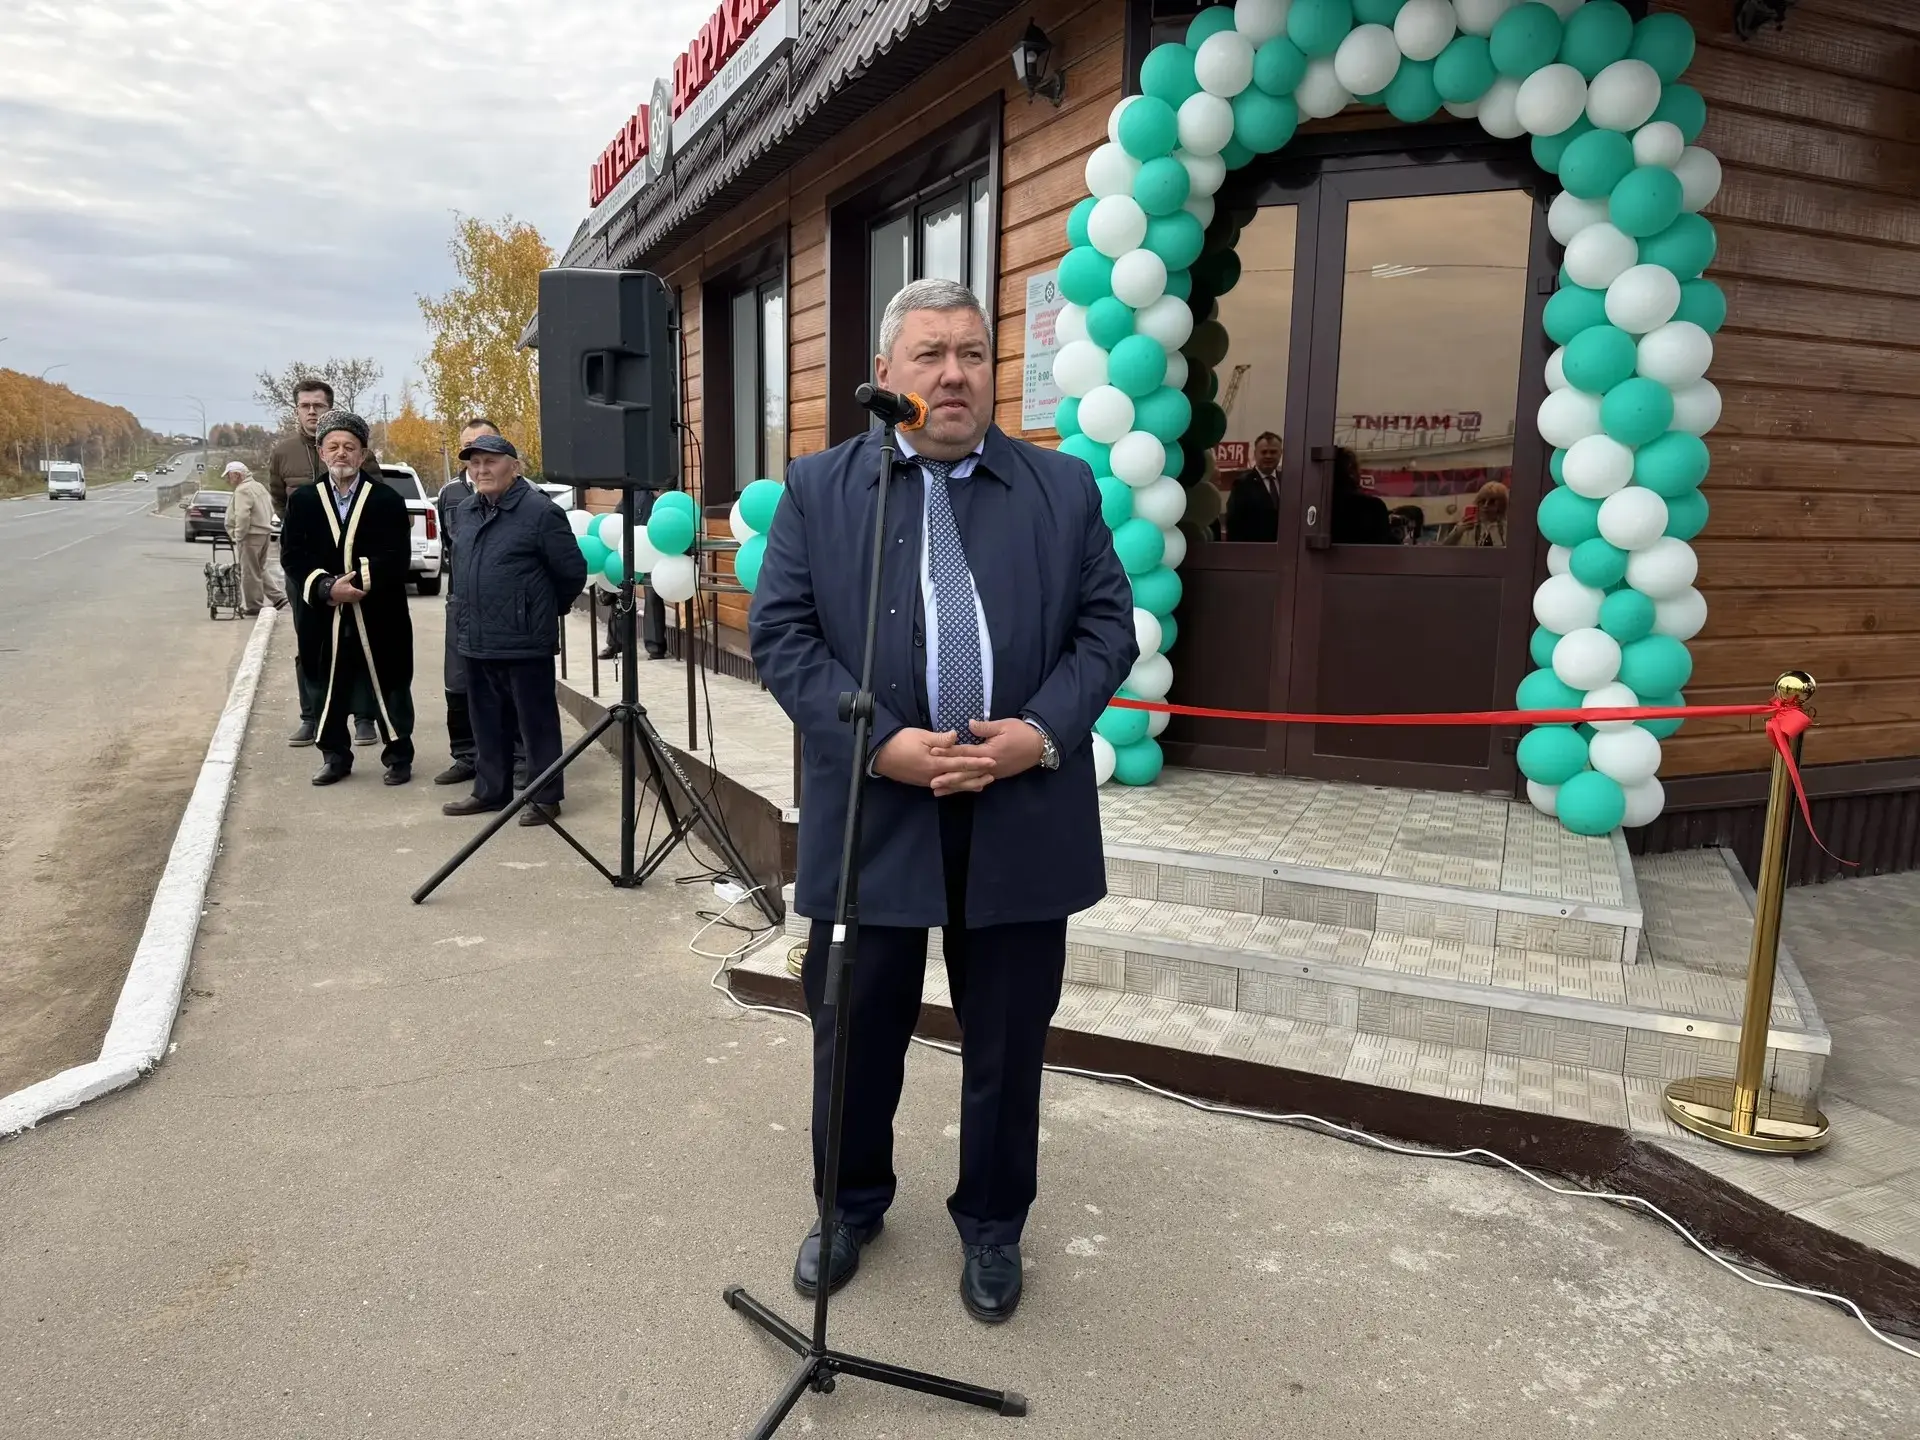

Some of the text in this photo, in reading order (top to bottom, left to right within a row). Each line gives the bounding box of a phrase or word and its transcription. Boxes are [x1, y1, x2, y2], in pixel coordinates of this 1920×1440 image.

[672, 0, 779, 123] ДАРУХА
[590, 104, 648, 207] АПТЕКА
[631, 165, 644, 189] СЕТЬ
